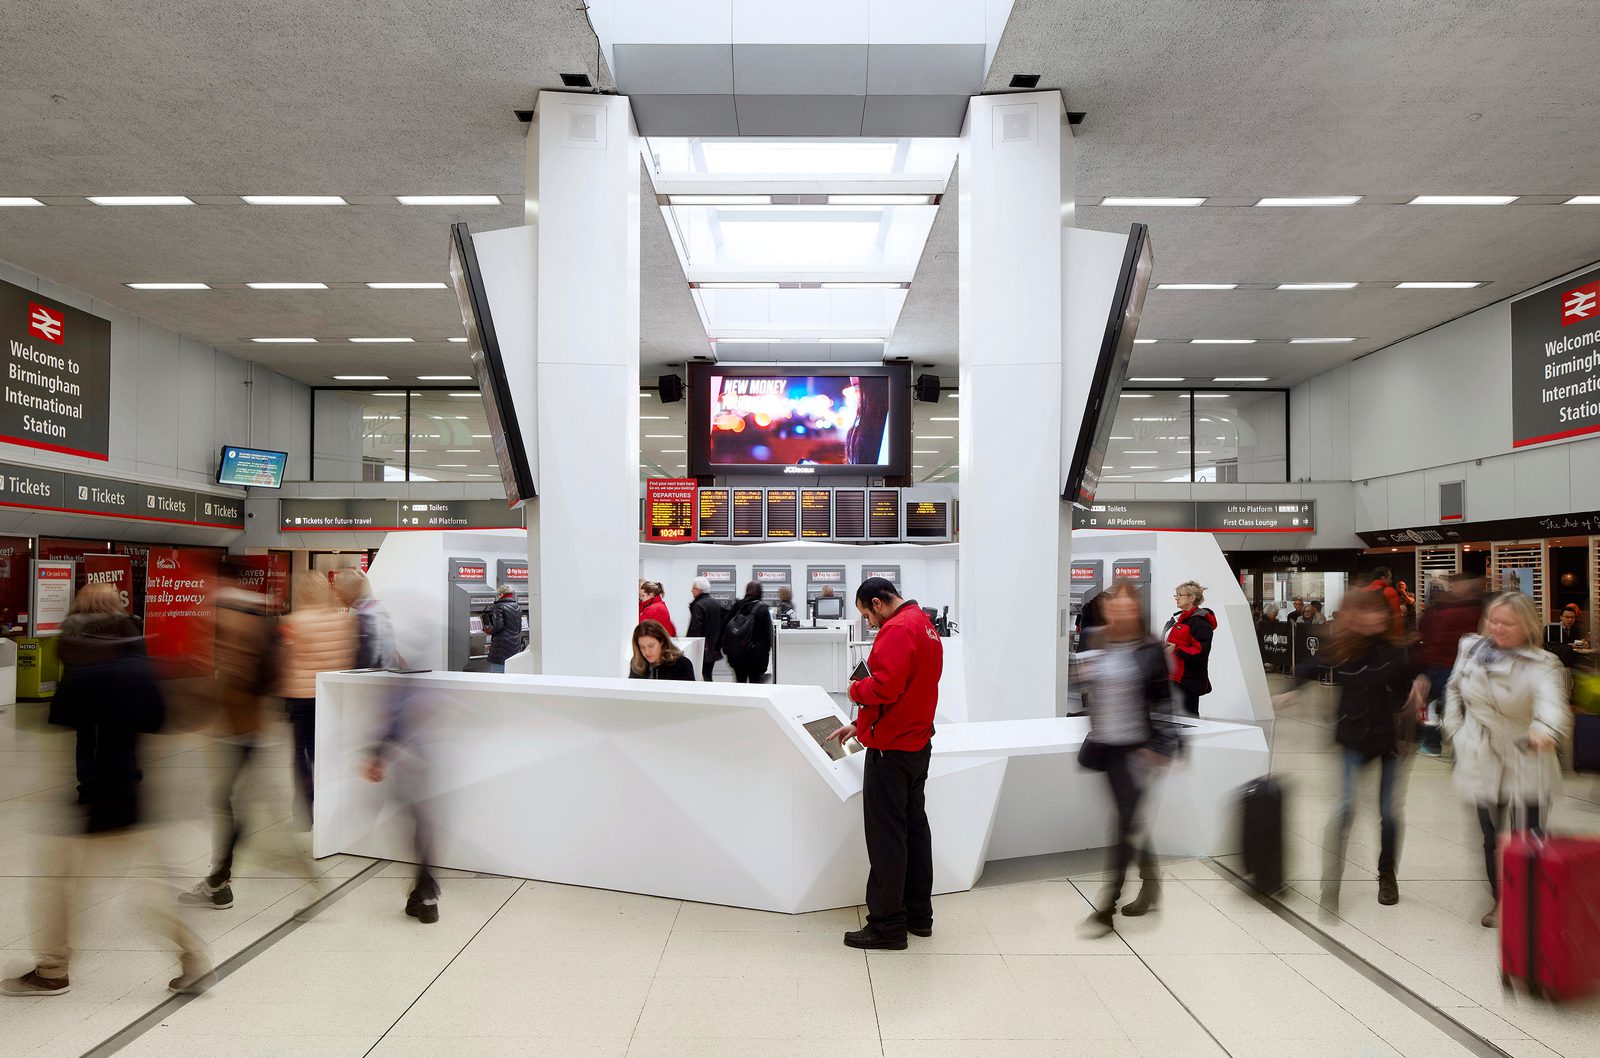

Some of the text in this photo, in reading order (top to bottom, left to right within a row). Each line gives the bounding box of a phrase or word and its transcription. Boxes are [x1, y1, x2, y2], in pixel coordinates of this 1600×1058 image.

[10, 340, 80, 375] Welcome to
[9, 363, 80, 396] Birmingham
[725, 379, 787, 394] NEW MONEY
[5, 386, 83, 419] International
[23, 415, 66, 438] Station
[784, 466, 815, 474] JCDecaux
[9, 476, 51, 496] Tickets
[91, 488, 125, 505] Tickets
[157, 497, 186, 513] Tickets
[213, 504, 238, 518] Tickets
[324, 517, 333, 525] for
[334, 517, 353, 525] future
[1255, 519, 1278, 527] Lounge
[1539, 518, 1560, 529] The
[1582, 519, 1591, 530] of
[87, 569, 125, 584] PARENT
[161, 575, 173, 588] let
[174, 579, 205, 590] great
[157, 590, 174, 605] slip
[175, 594, 205, 605] away
[167, 610, 211, 618] virgintrains.com
